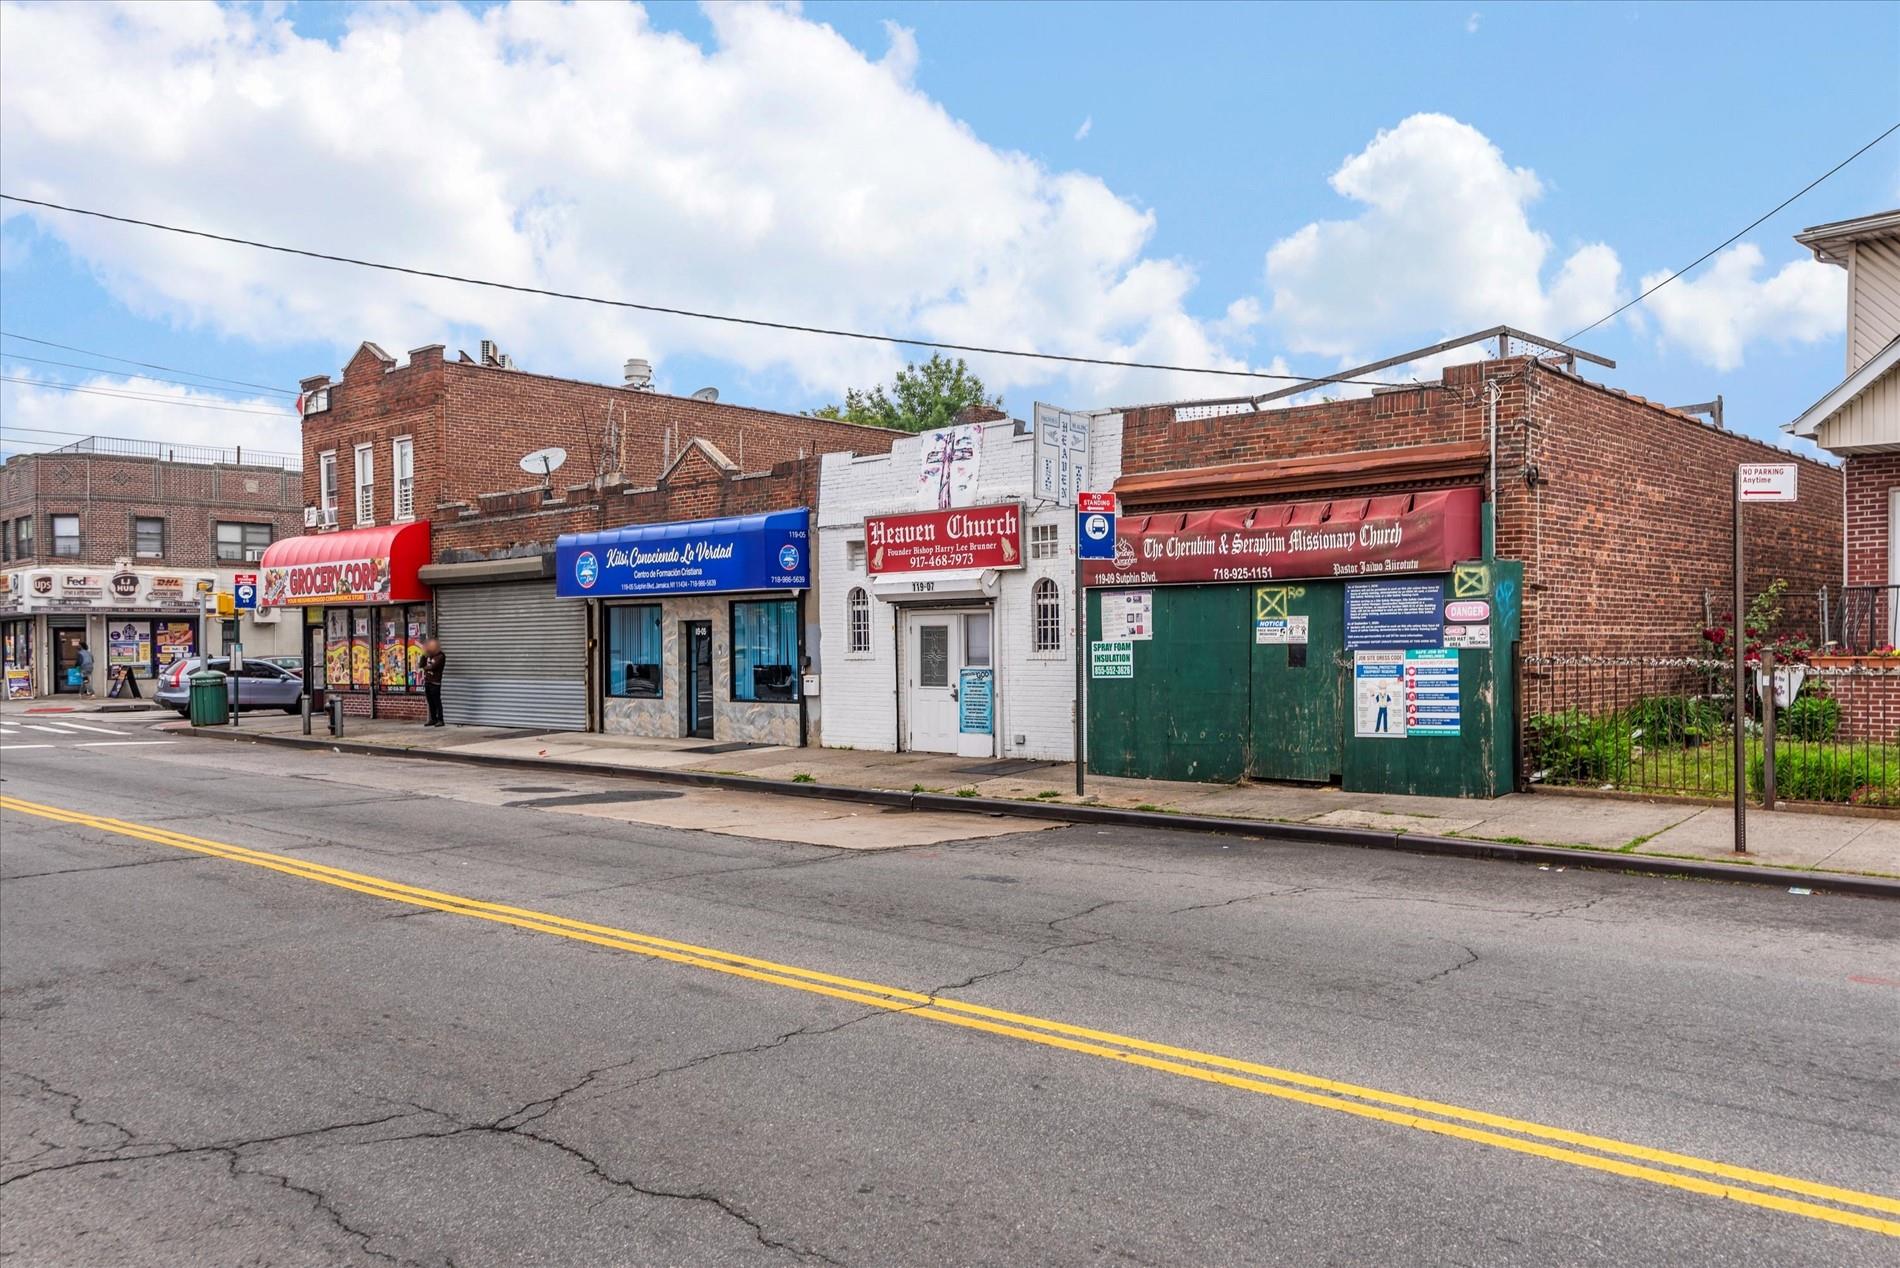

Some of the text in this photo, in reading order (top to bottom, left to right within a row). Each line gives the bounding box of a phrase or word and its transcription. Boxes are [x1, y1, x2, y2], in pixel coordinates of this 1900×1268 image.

[869, 510, 1017, 546] Heaven Church
[1143, 521, 1403, 561] The Cherubim & Seraphim Missionary Church
[630, 547, 680, 568] Conociendo
[680, 542, 695, 565] La
[696, 541, 734, 562] Verdad
[887, 542, 997, 557] Founder Bishop Harry Lee Brunner
[910, 553, 974, 568] 917-468-7973
[633, 570, 650, 579] Centro
[650, 569, 656, 578] de
[681, 568, 702, 577] Cristiana
[1213, 567, 1273, 580] 718-925-1151
[1333, 563, 1358, 576] Pastor
[66, 576, 99, 586] FedEx
[289, 562, 378, 596] GROCERY CORP
[1095, 571, 1158, 585] 119-09 Sutphin Blvd.
[34, 581, 51, 592] ups
[911, 581, 935, 592] 119-07
[1450, 606, 1484, 617] DANGER
[1093, 642, 1131, 652] SPRAY FOAM
[1094, 654, 1131, 663] INSULATION
